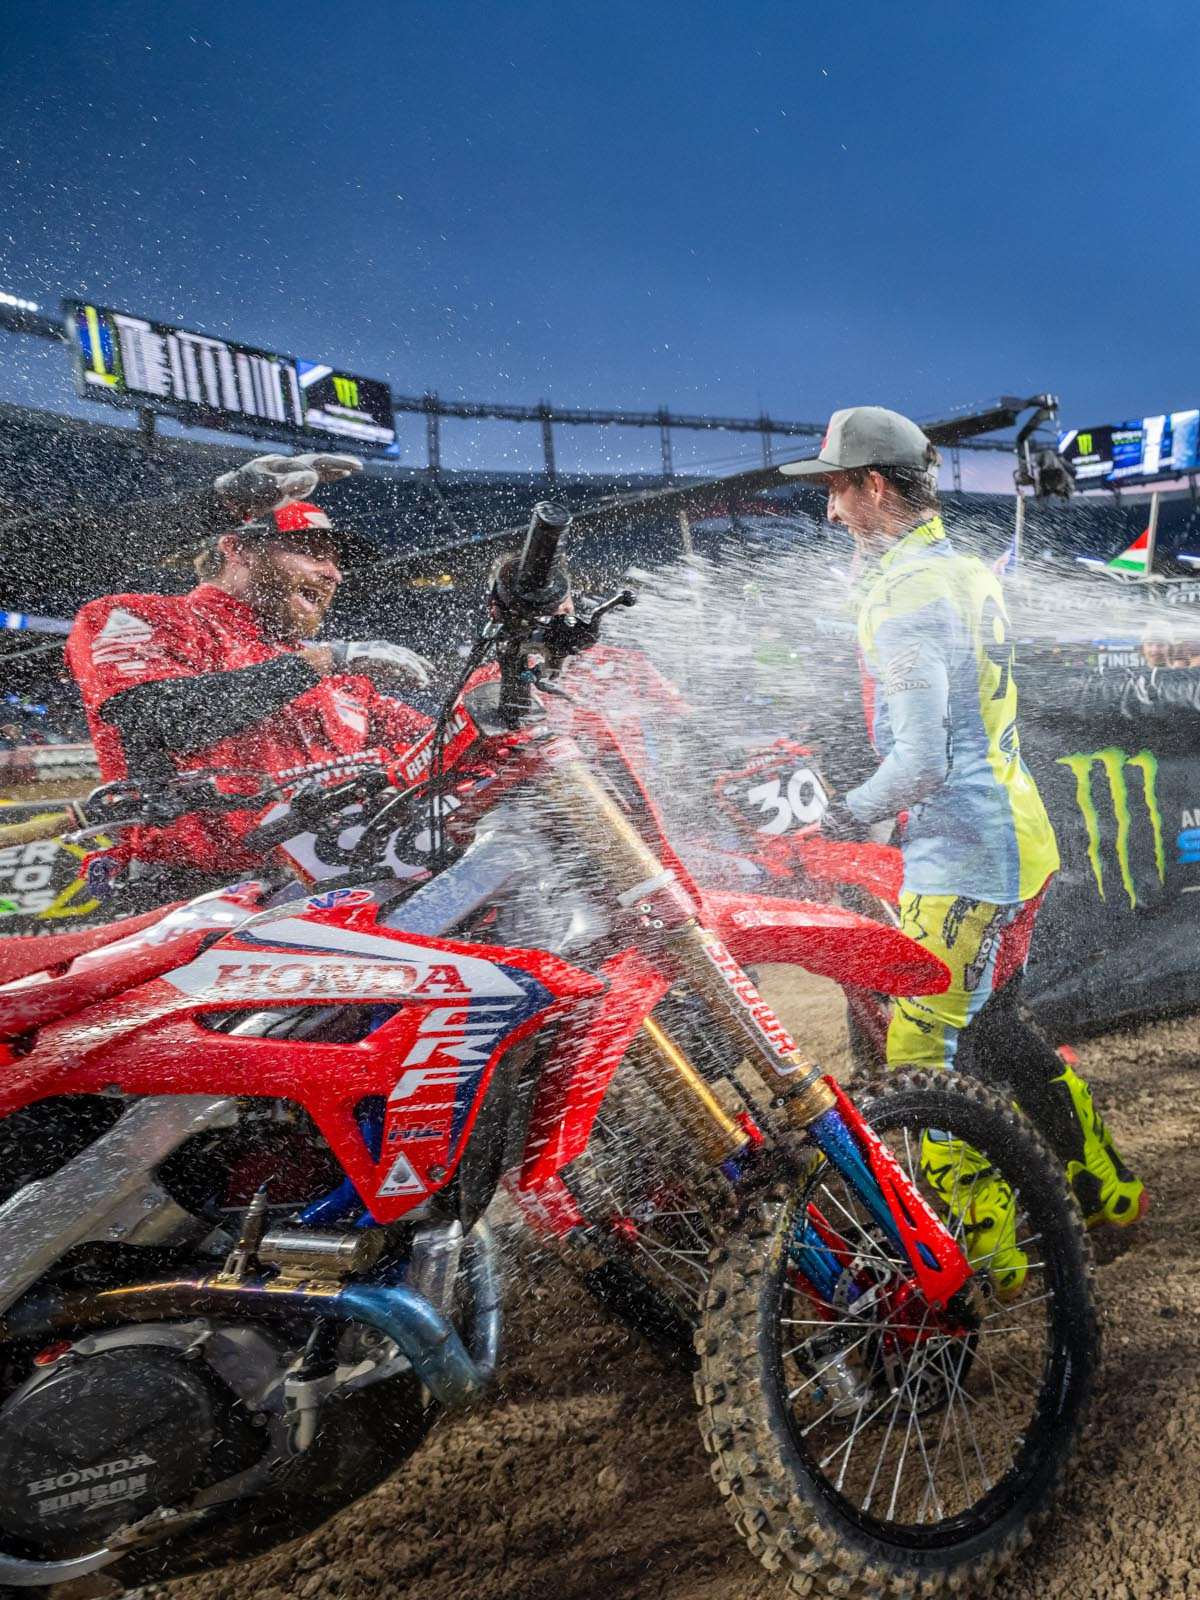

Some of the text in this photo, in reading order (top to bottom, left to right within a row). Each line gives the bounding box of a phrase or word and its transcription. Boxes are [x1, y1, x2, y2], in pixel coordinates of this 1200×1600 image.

[1098, 652, 1146, 667] FINIS
[747, 768, 829, 835] 30
[215, 963, 472, 994] HONDA
[27, 1453, 157, 1496] HONDA
[38, 1474, 147, 1514] HINSON
